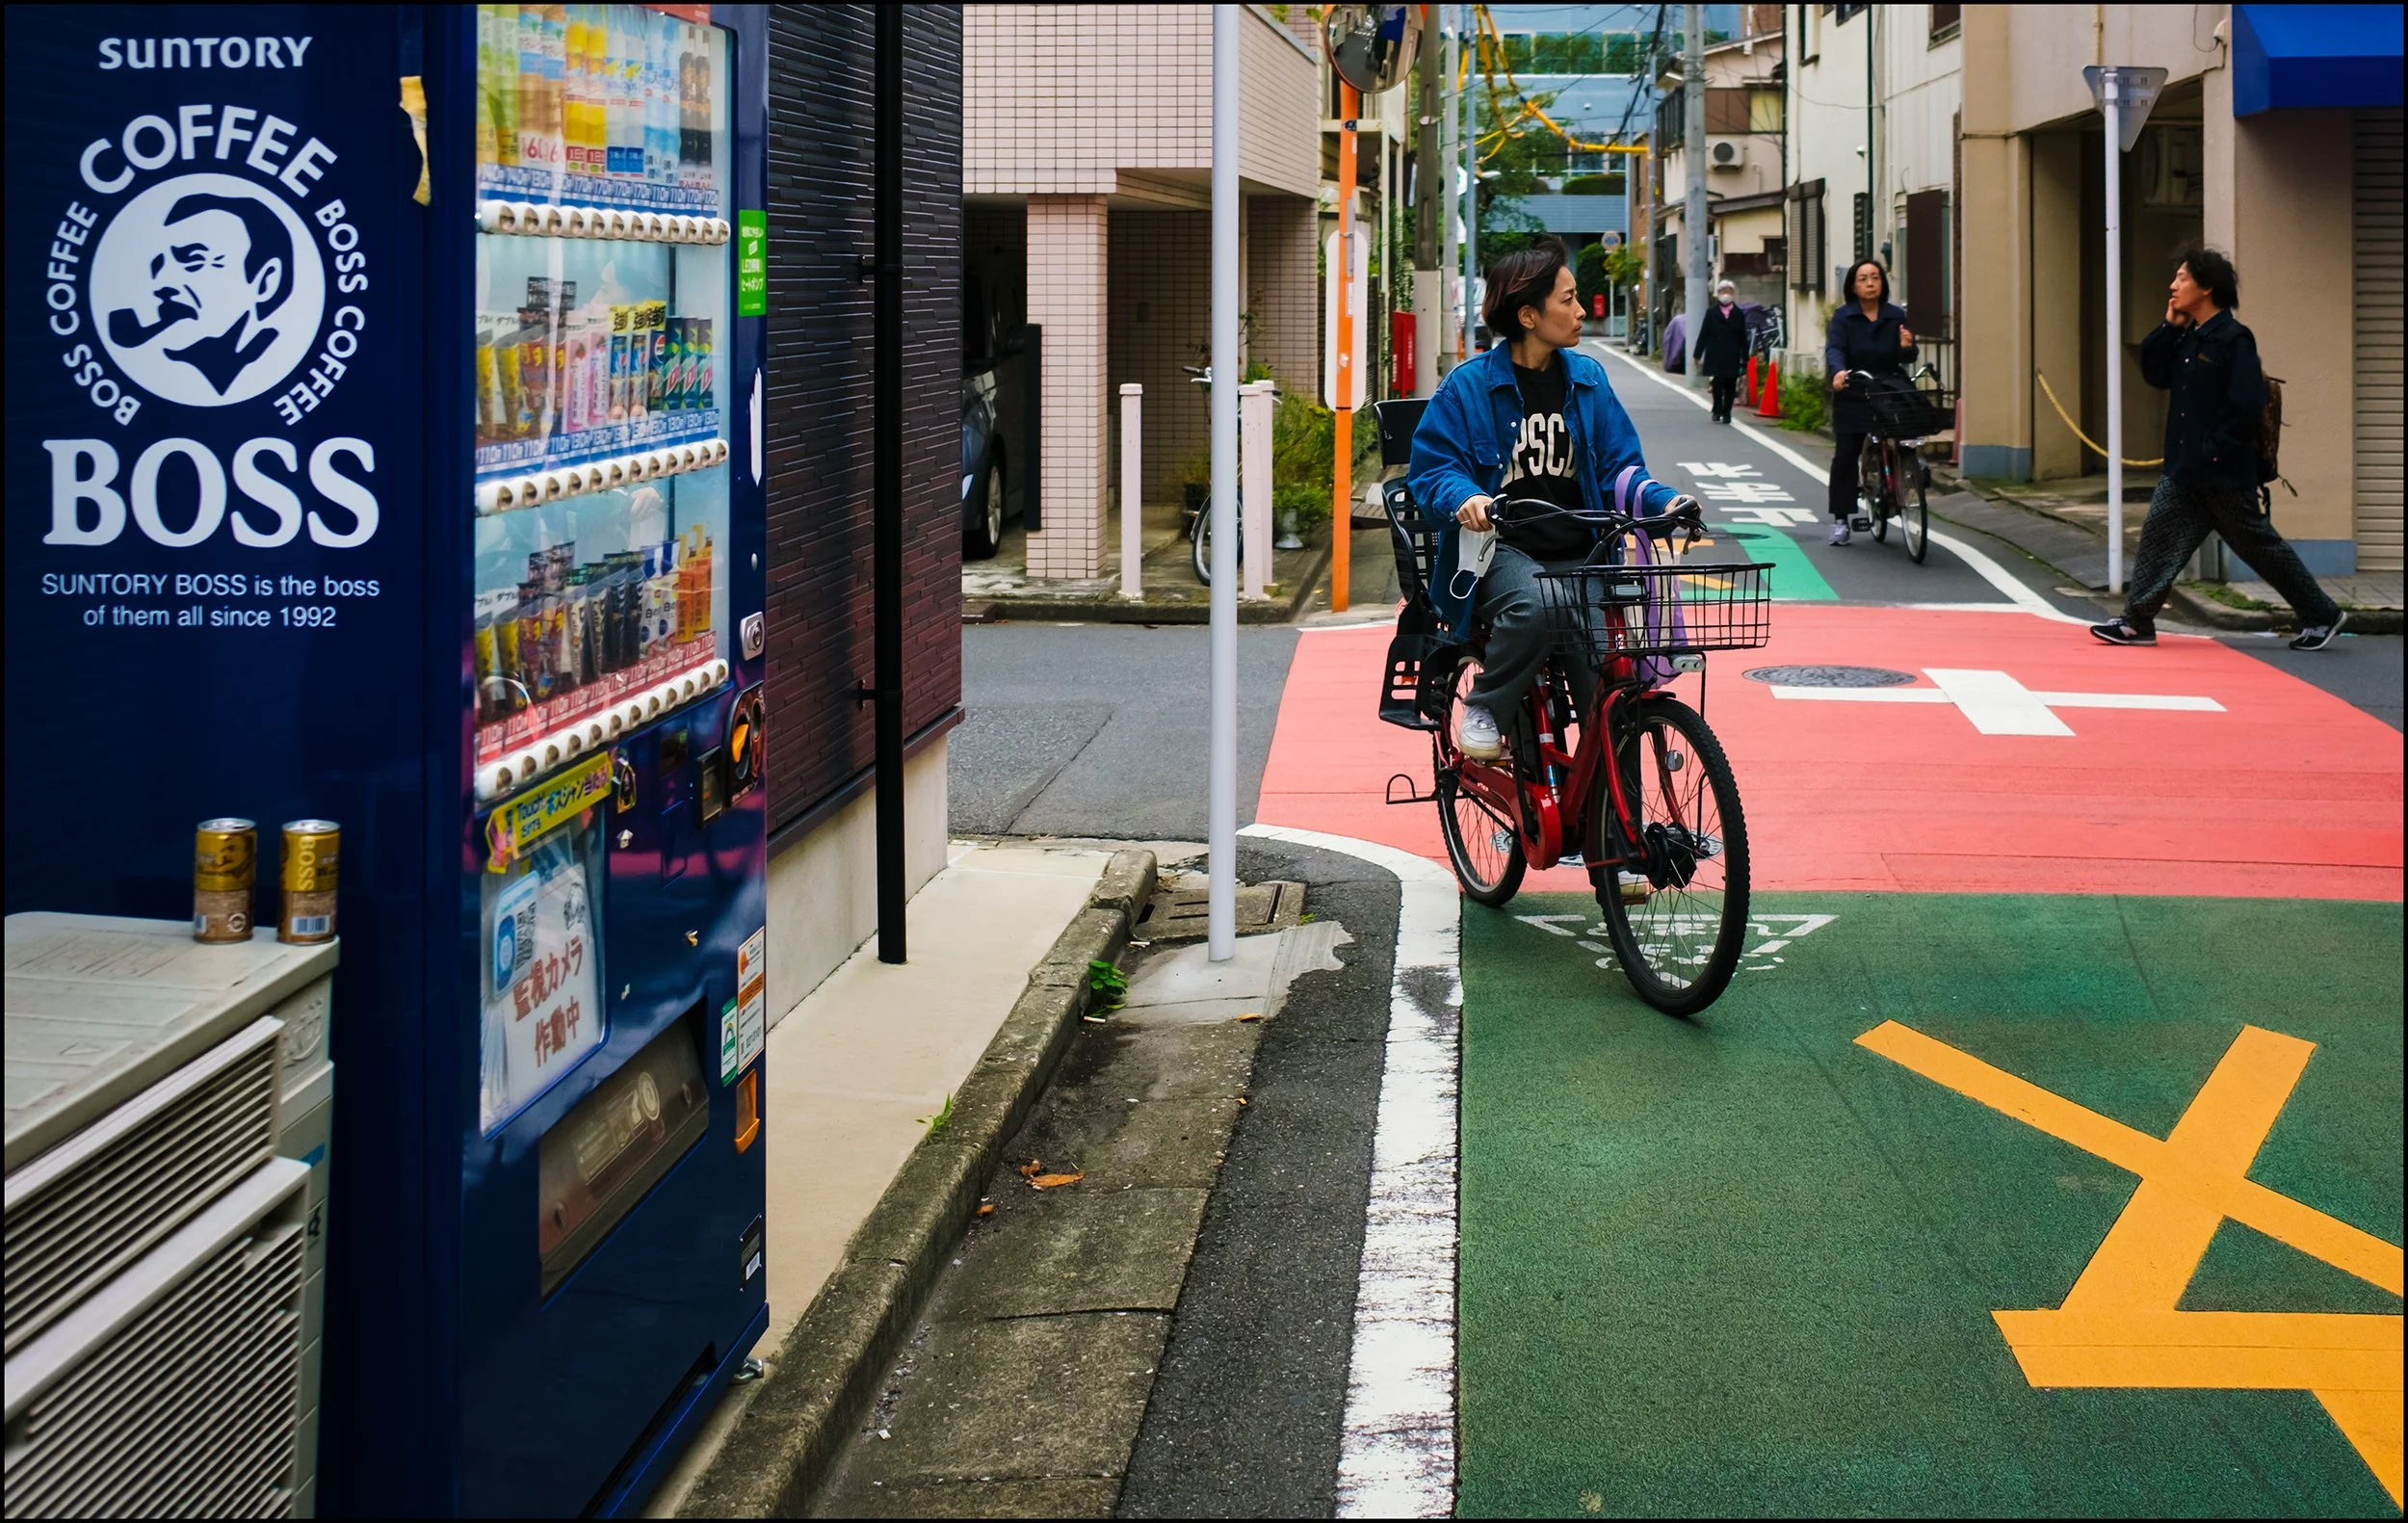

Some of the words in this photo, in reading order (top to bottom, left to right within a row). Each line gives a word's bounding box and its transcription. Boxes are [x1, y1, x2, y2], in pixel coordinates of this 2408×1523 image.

[80, 104, 338, 197] COFFEE
[46, 201, 97, 335] COFFEE
[315, 199, 368, 293] BOSS
[63, 343, 141, 426] BOSS
[274, 306, 365, 425] COFFEE
[42, 436, 379, 548] BOSS
[41, 574, 168, 595] SUNTORY
[175, 575, 247, 596] BOSS
[254, 574, 274, 596] is
[280, 575, 317, 596] the
[324, 576, 380, 597] boss
[83, 605, 107, 627] of
[113, 605, 170, 627] them
[177, 606, 202, 627] all
[210, 606, 271, 627] since
[281, 606, 336, 627] 1992
[299, 836, 316, 891] BOSS
[513, 935, 583, 1022] 監視カメラ
[534, 995, 581, 1068] 作動中
